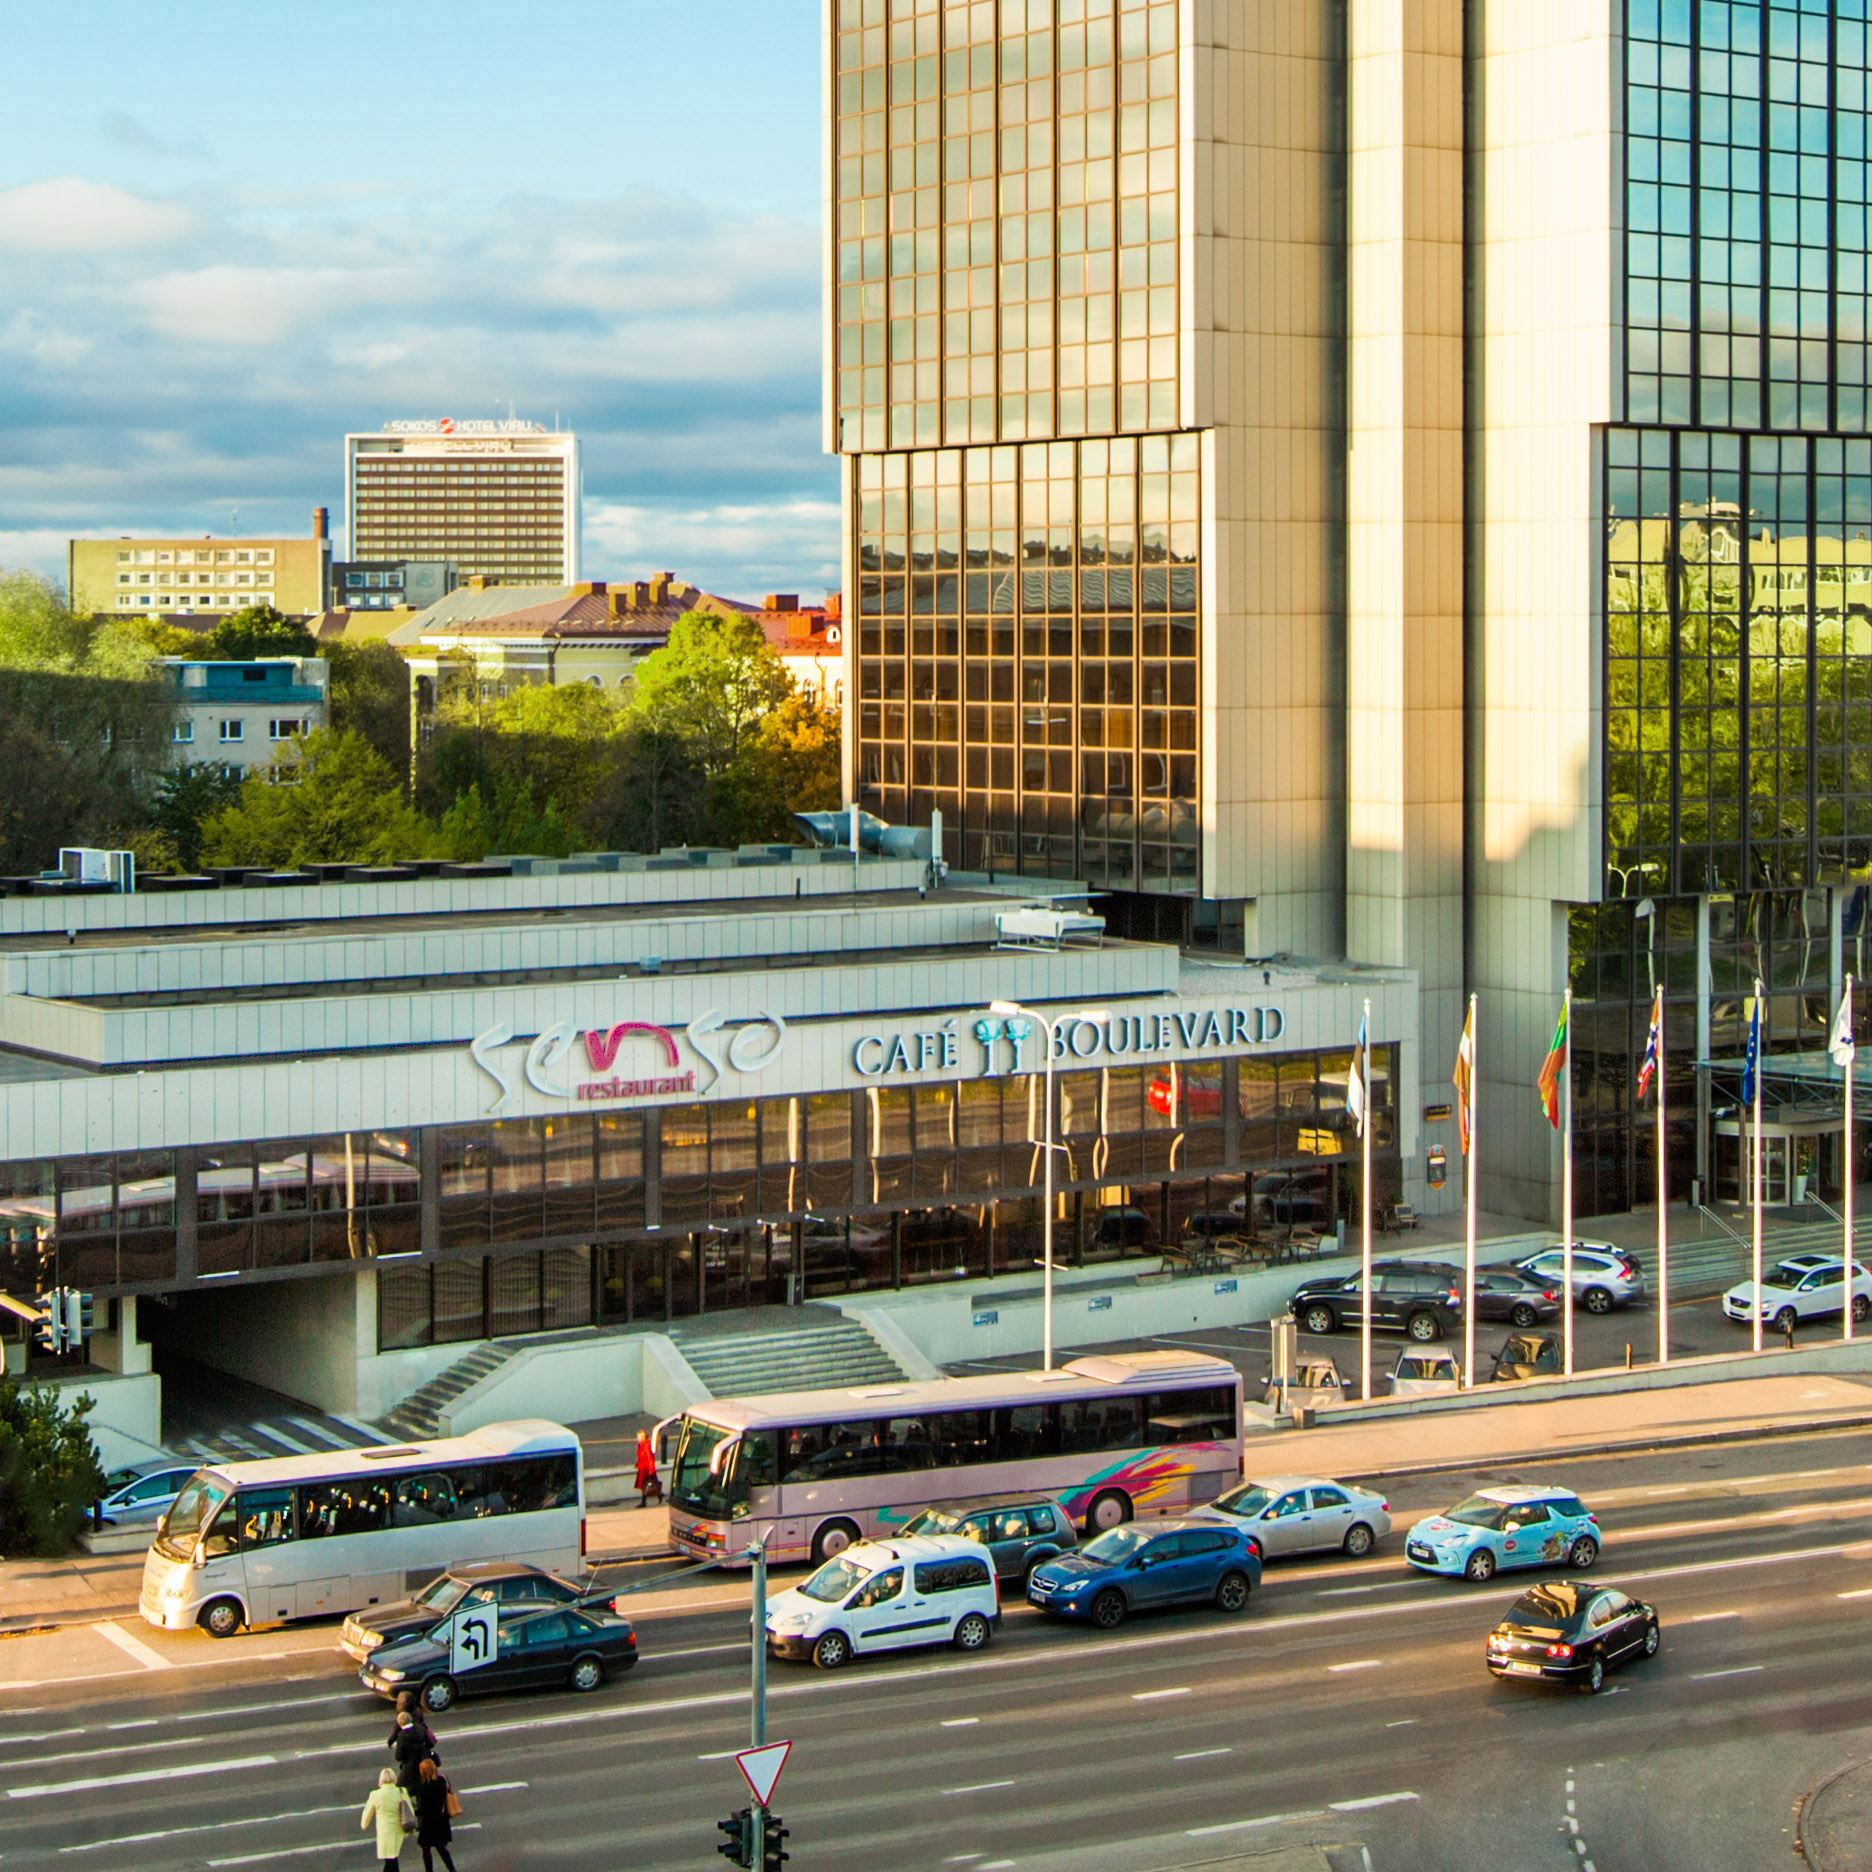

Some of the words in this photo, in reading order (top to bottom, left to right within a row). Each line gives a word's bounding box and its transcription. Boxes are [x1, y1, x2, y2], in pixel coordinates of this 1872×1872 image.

[391, 419, 436, 432] SOKOS
[456, 419, 497, 432] HOTEL
[498, 419, 532, 432] VIRU
[853, 1018, 958, 1076] CAFÉ
[1045, 1006, 1286, 1060] BOULEVARD
[578, 1070, 696, 1101] restaurant
